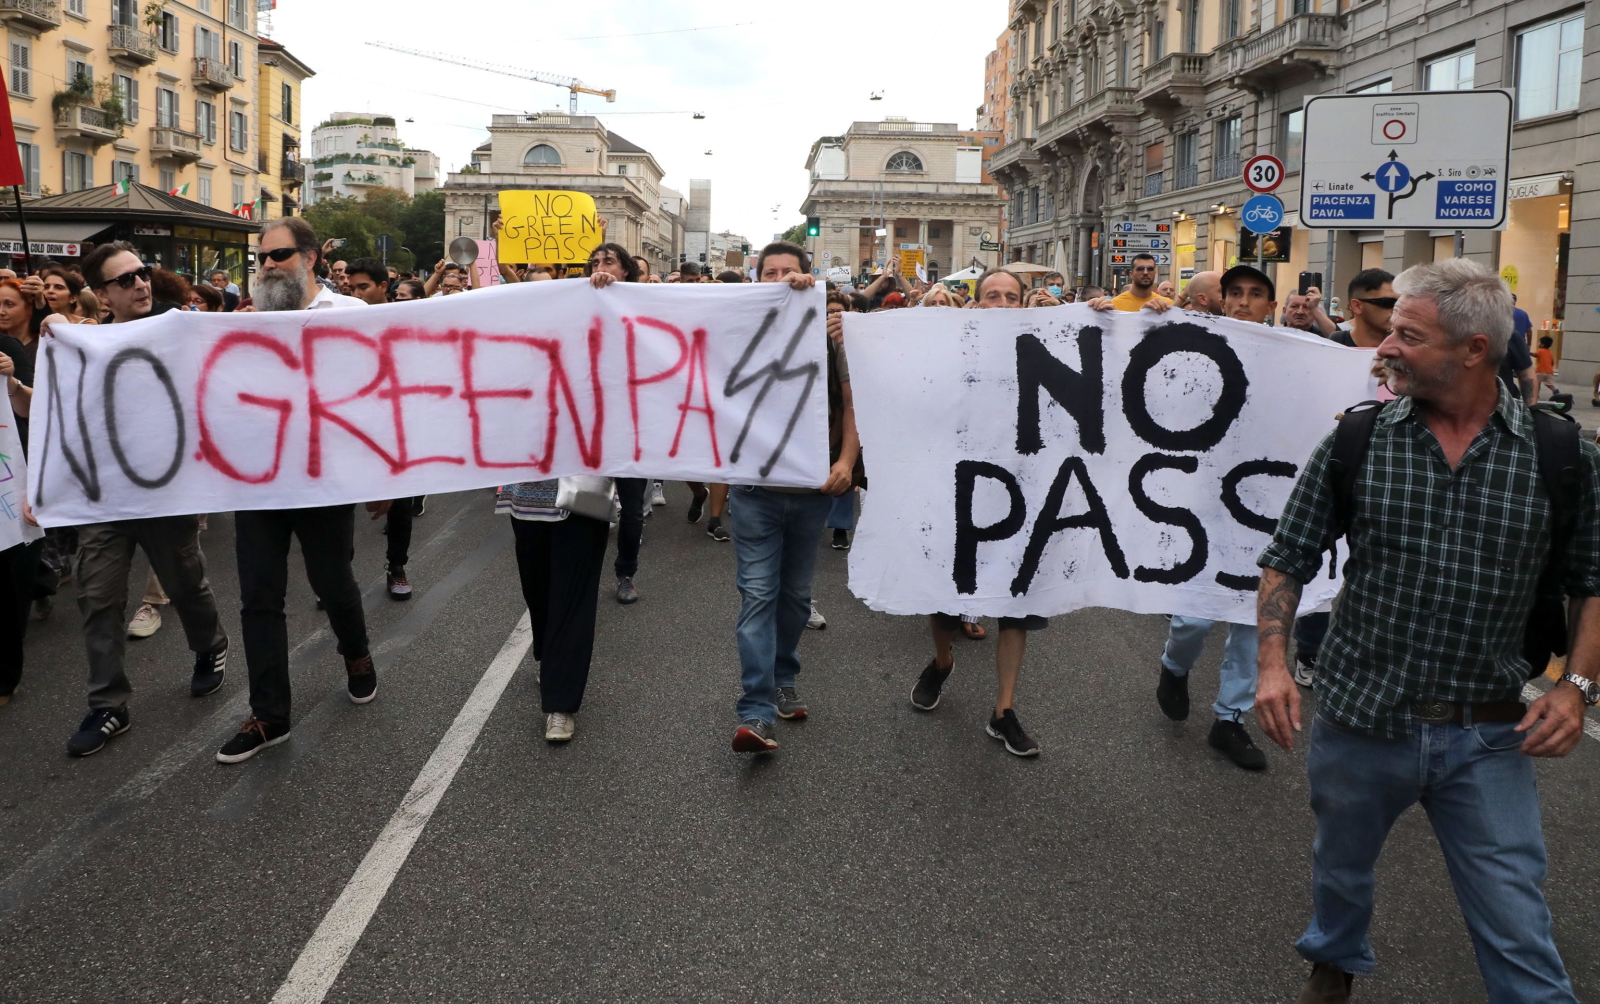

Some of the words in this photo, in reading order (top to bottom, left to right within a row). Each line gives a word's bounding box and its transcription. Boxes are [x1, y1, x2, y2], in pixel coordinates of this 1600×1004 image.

[1252, 165, 1276, 182] 30
[1437, 168, 1444, 177] S.
[1448, 167, 1462, 177] Siro
[1328, 182, 1354, 191] Linate
[1454, 182, 1493, 192] COMO
[534, 193, 573, 218] NO
[1312, 196, 1371, 205] PIACENZA
[1444, 195, 1493, 205] VARESE
[1311, 209, 1345, 217] PAVIA
[1439, 208, 1492, 217] NOVARA
[505, 211, 596, 239] GREEN
[31, 243, 45, 253] COLD
[47, 244, 64, 254] DRINK
[523, 235, 593, 261] PASS
[1014, 321, 1250, 456] NO
[34, 342, 186, 509] NO
[195, 317, 602, 485] GREEN
[622, 306, 821, 478] PASS
[951, 452, 1299, 598] PASS
